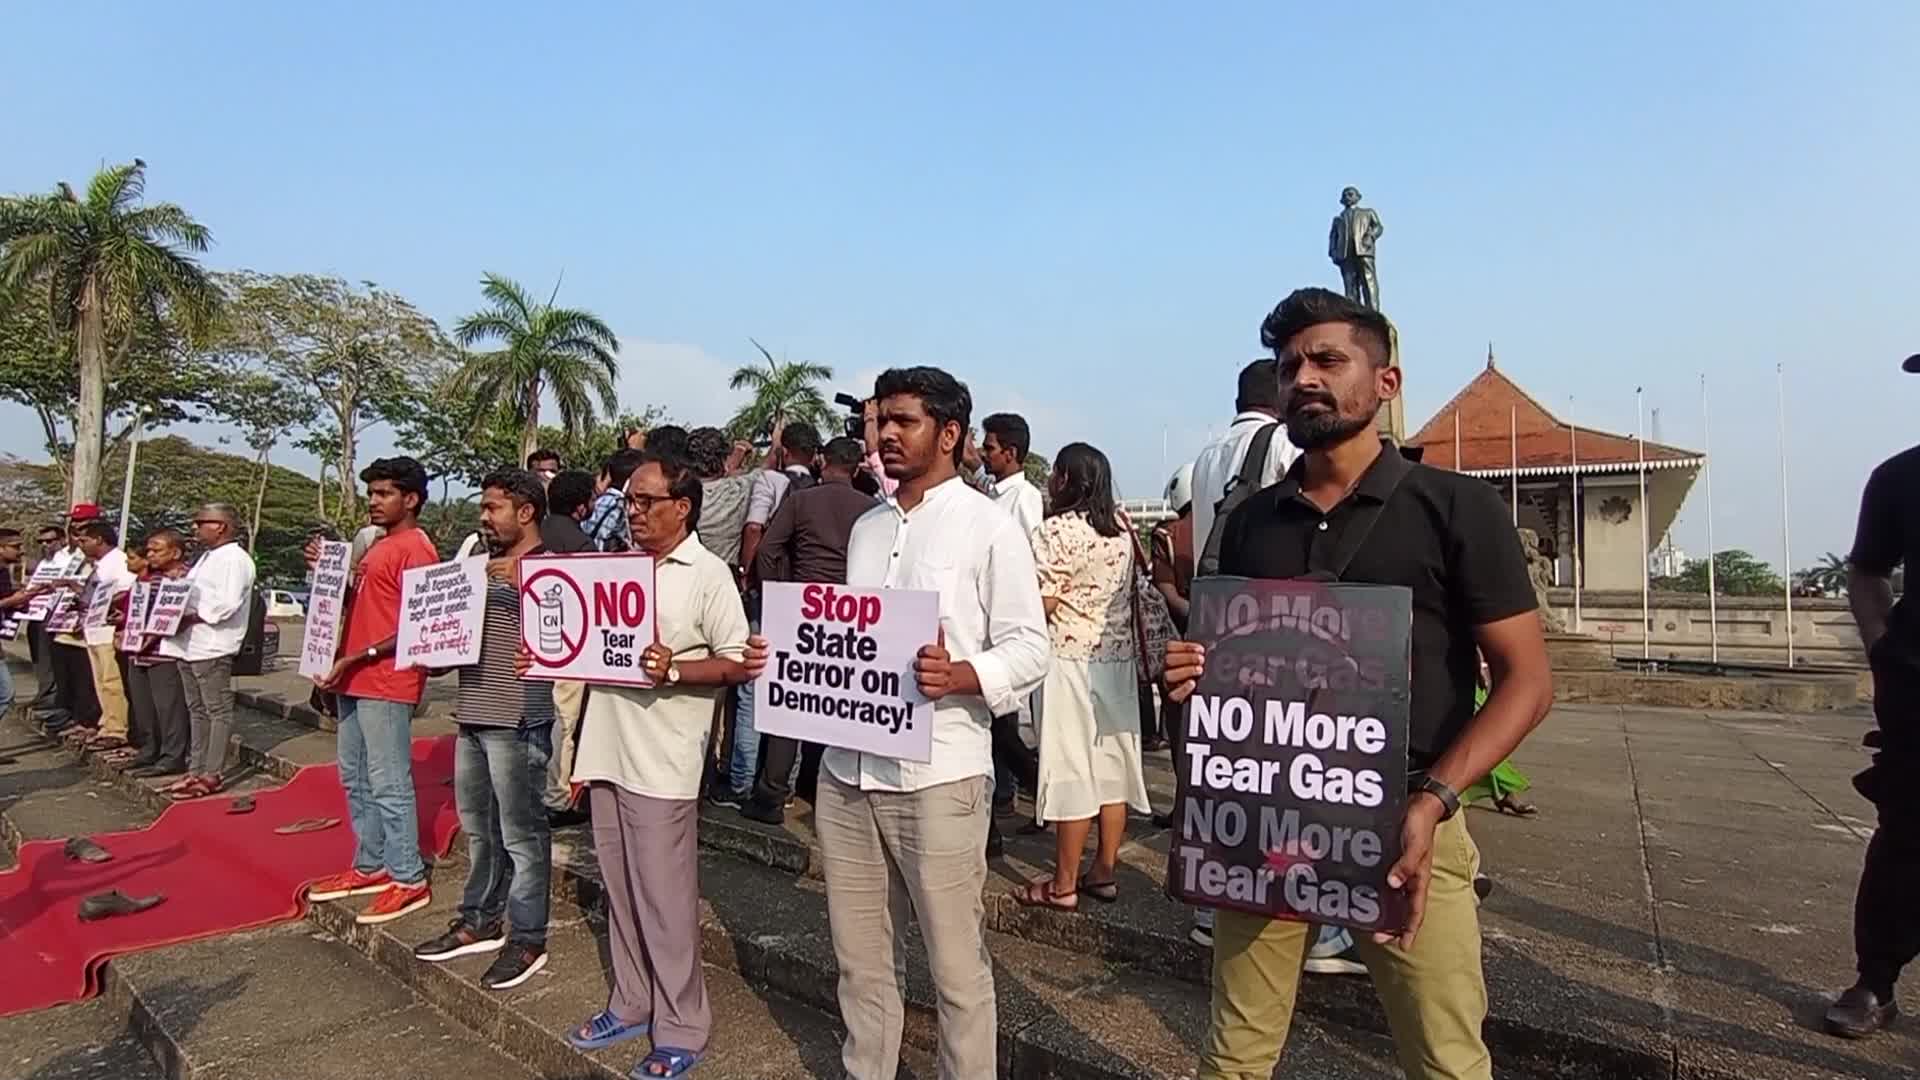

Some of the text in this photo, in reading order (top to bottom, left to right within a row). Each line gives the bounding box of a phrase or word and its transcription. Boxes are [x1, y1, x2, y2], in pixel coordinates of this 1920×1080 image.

[543, 615, 558, 627] CN
[594, 581, 645, 628] NO
[801, 584, 881, 632] Stop
[1198, 593, 1384, 641] NO More
[601, 629, 635, 648] Tear
[602, 648, 632, 667] Gas
[796, 622, 877, 661] State
[776, 651, 899, 696] Terror on
[769, 682, 914, 734] Democracy!
[1189, 695, 1386, 754] NO More
[1186, 743, 1384, 807] Tear Gas
[1183, 797, 1382, 867] NO More
[1180, 846, 1380, 923] Tear Gas
